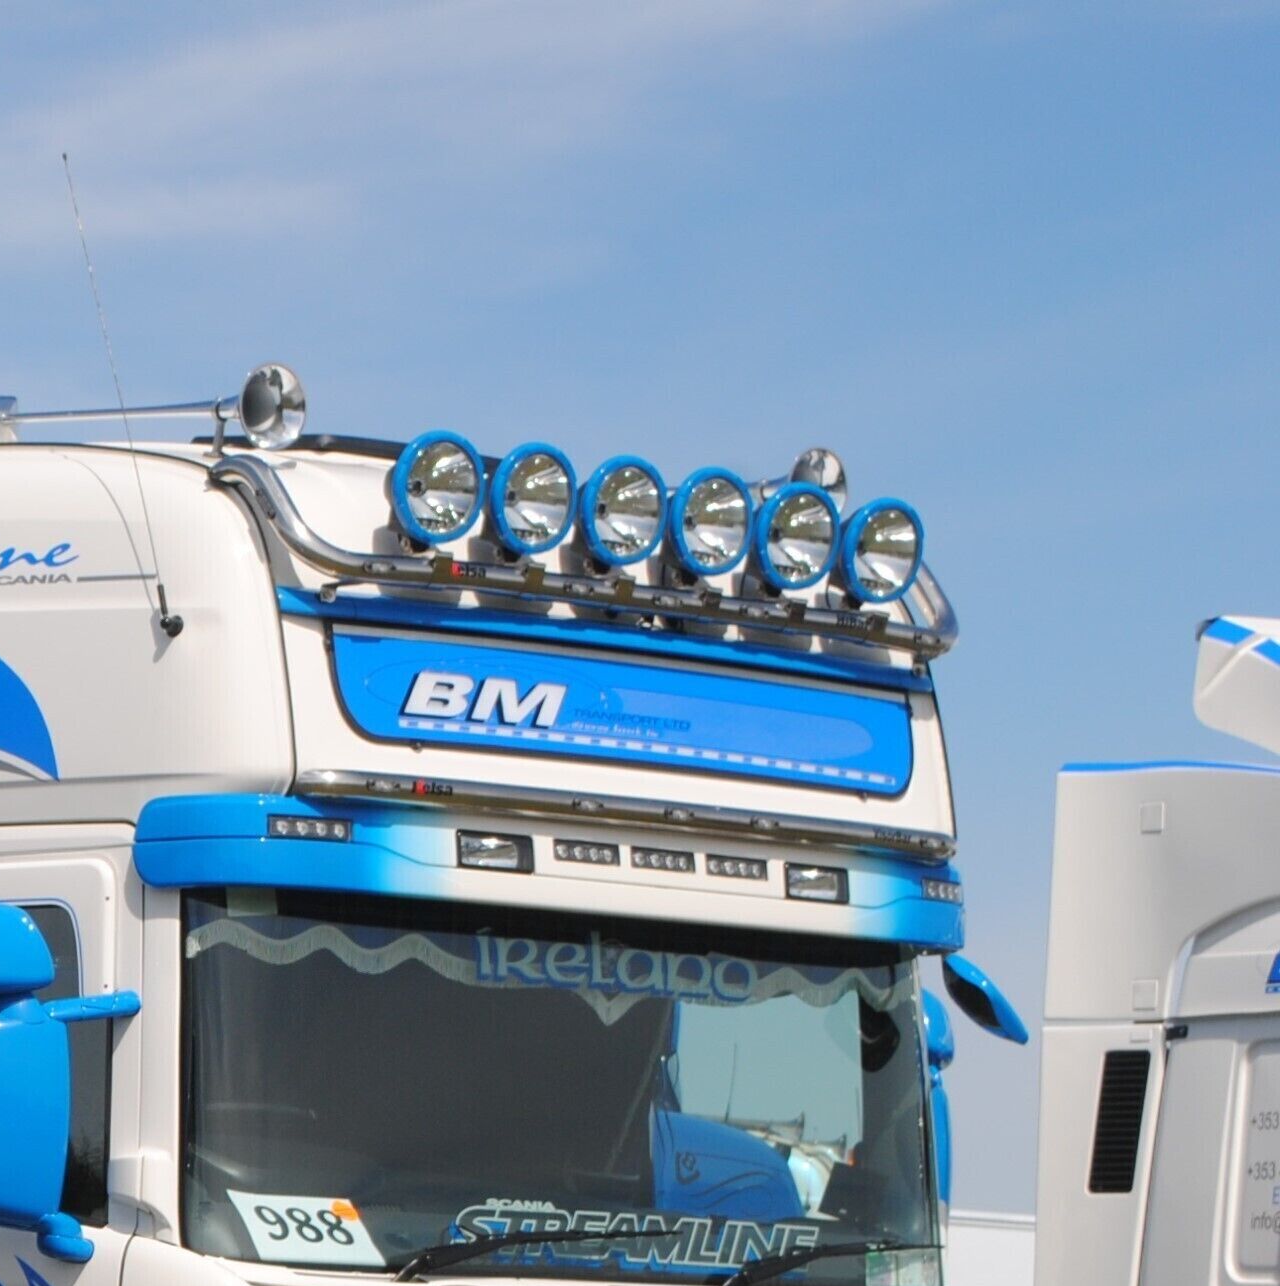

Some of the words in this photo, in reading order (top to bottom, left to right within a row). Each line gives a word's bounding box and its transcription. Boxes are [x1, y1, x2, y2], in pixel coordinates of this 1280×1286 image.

[398, 670, 567, 729] BM
[572, 708, 659, 731] TRANSPORT
[663, 717, 690, 731] LTD
[486, 1198, 557, 1211] SCANIA
[254, 1205, 354, 1245] 988
[449, 1204, 819, 1273] STREAMLINE
